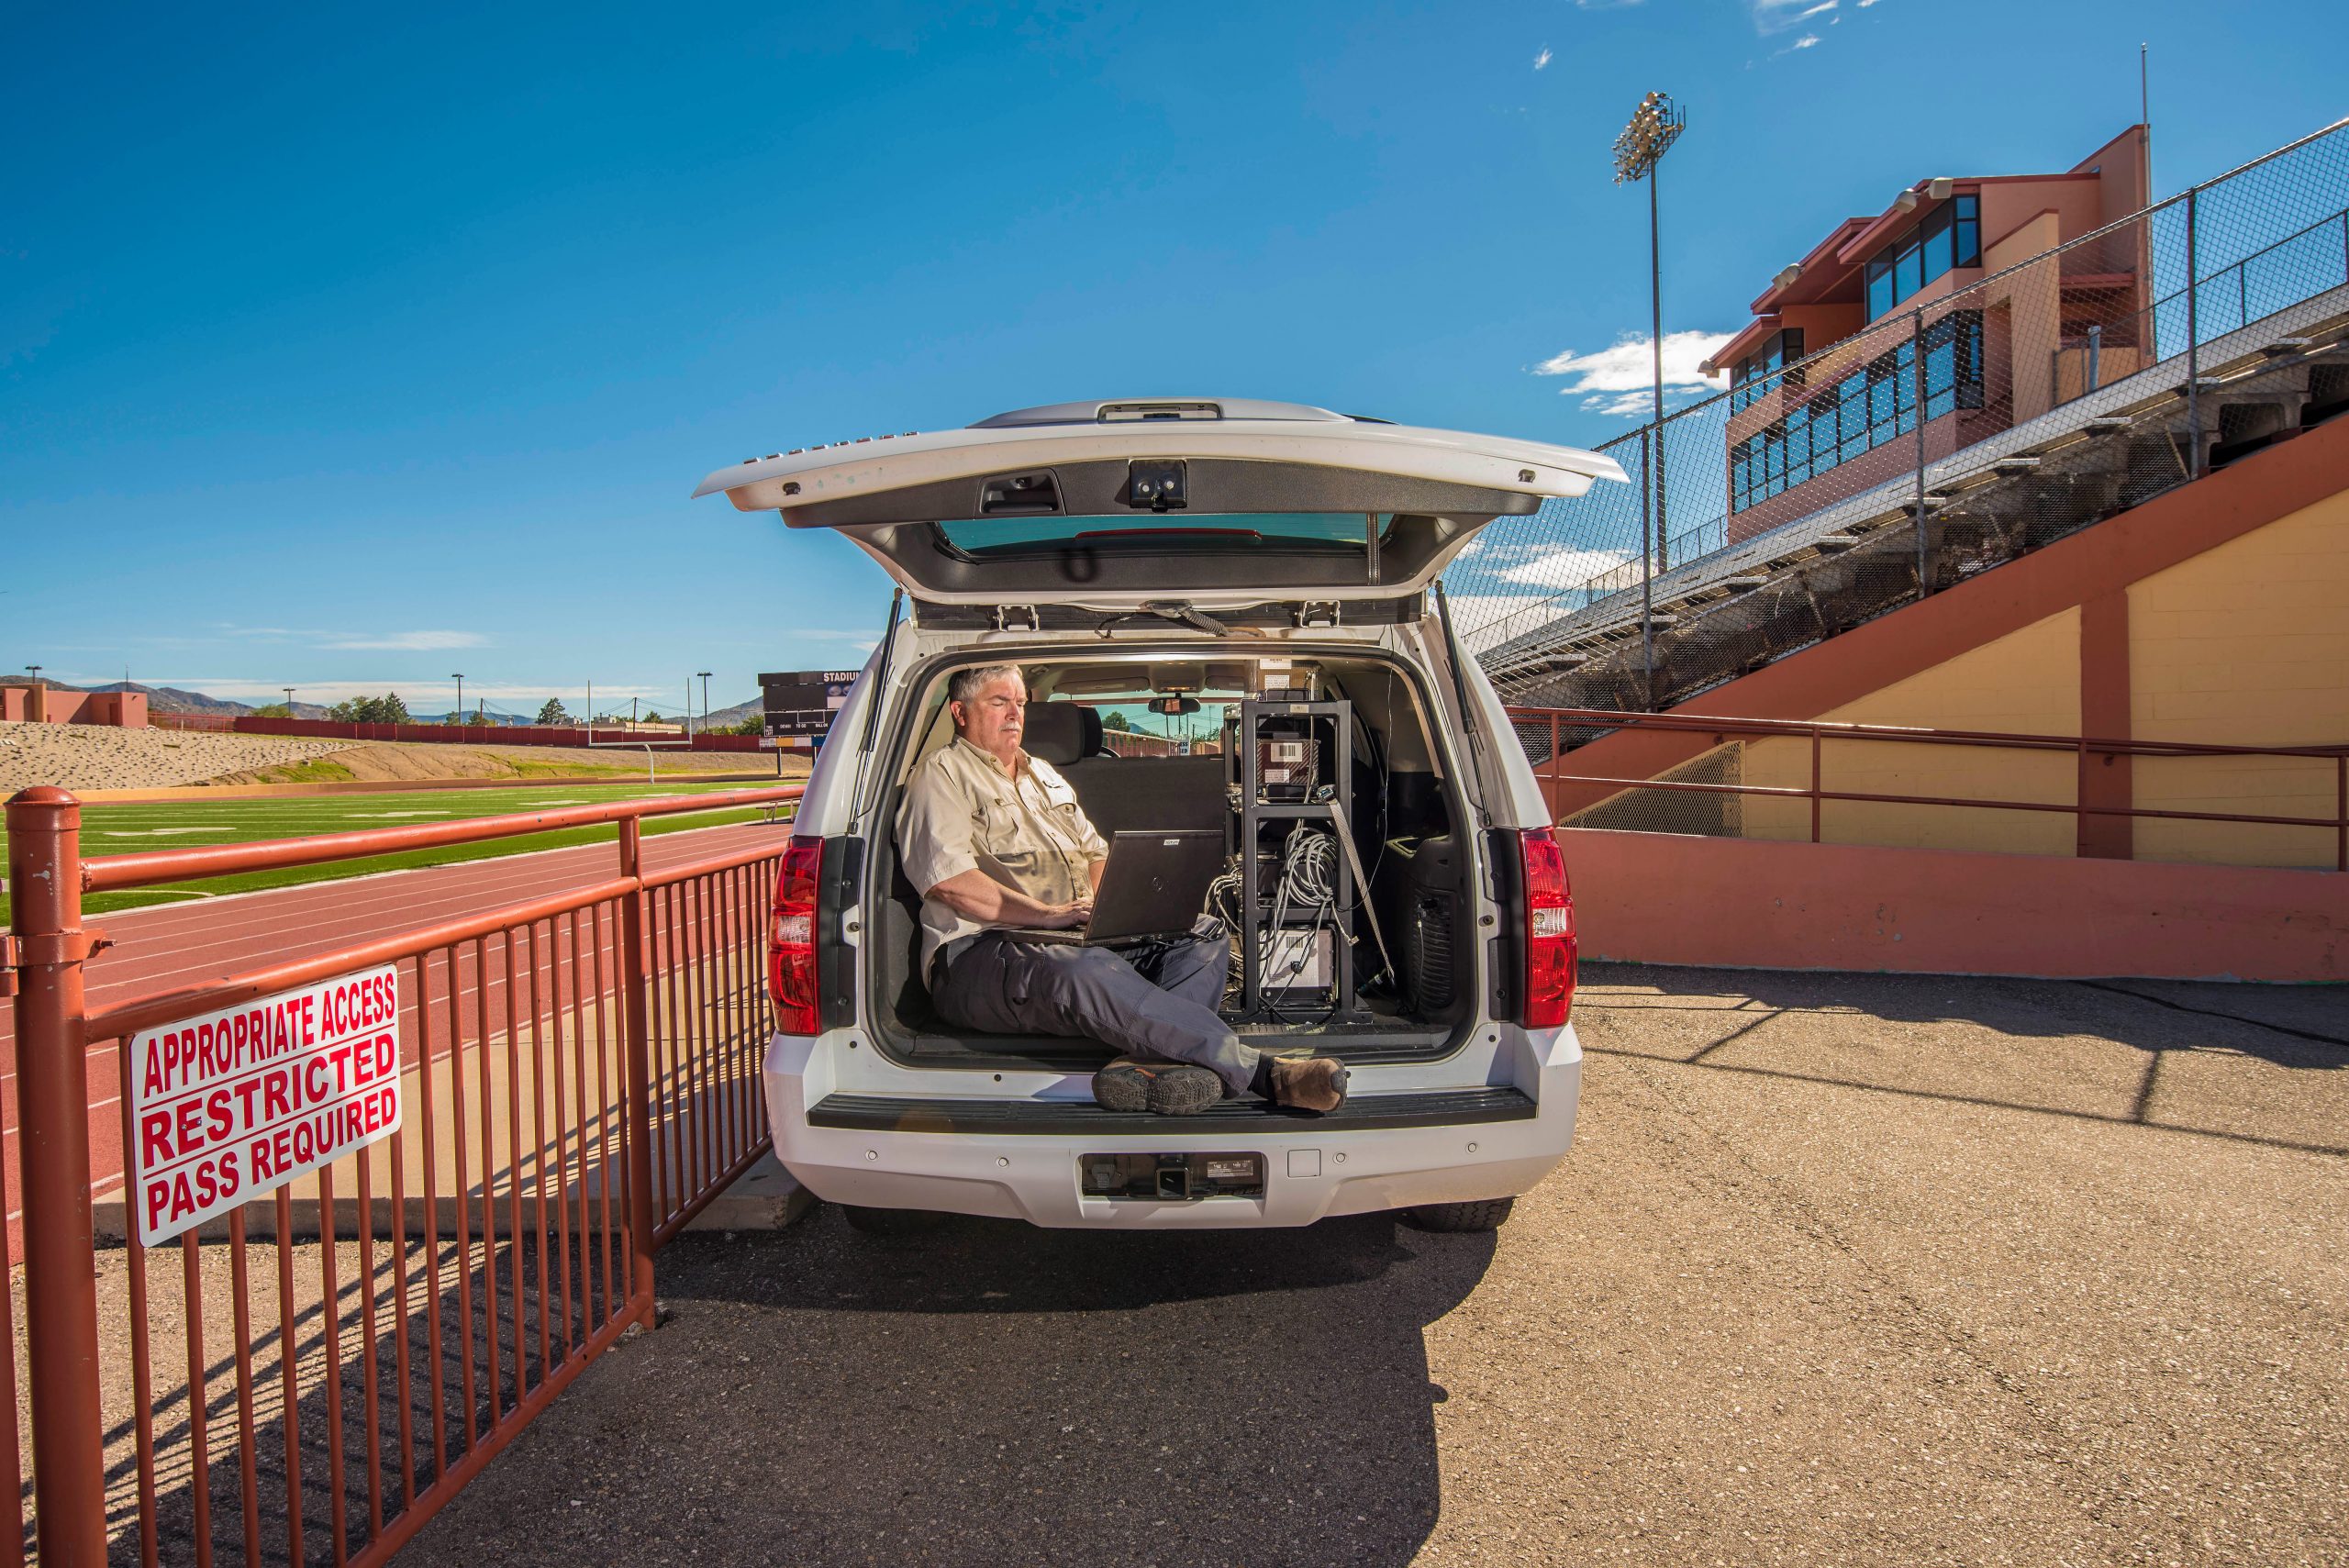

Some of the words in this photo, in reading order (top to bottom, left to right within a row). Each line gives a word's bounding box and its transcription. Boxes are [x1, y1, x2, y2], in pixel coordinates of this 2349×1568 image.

[141, 1034, 395, 1170] RESTRICTED
[143, 995, 314, 1099] APPROPRIATE
[321, 973, 395, 1041] ACCESS
[147, 1151, 239, 1232] PASS
[250, 1087, 396, 1186] REQUIRED
